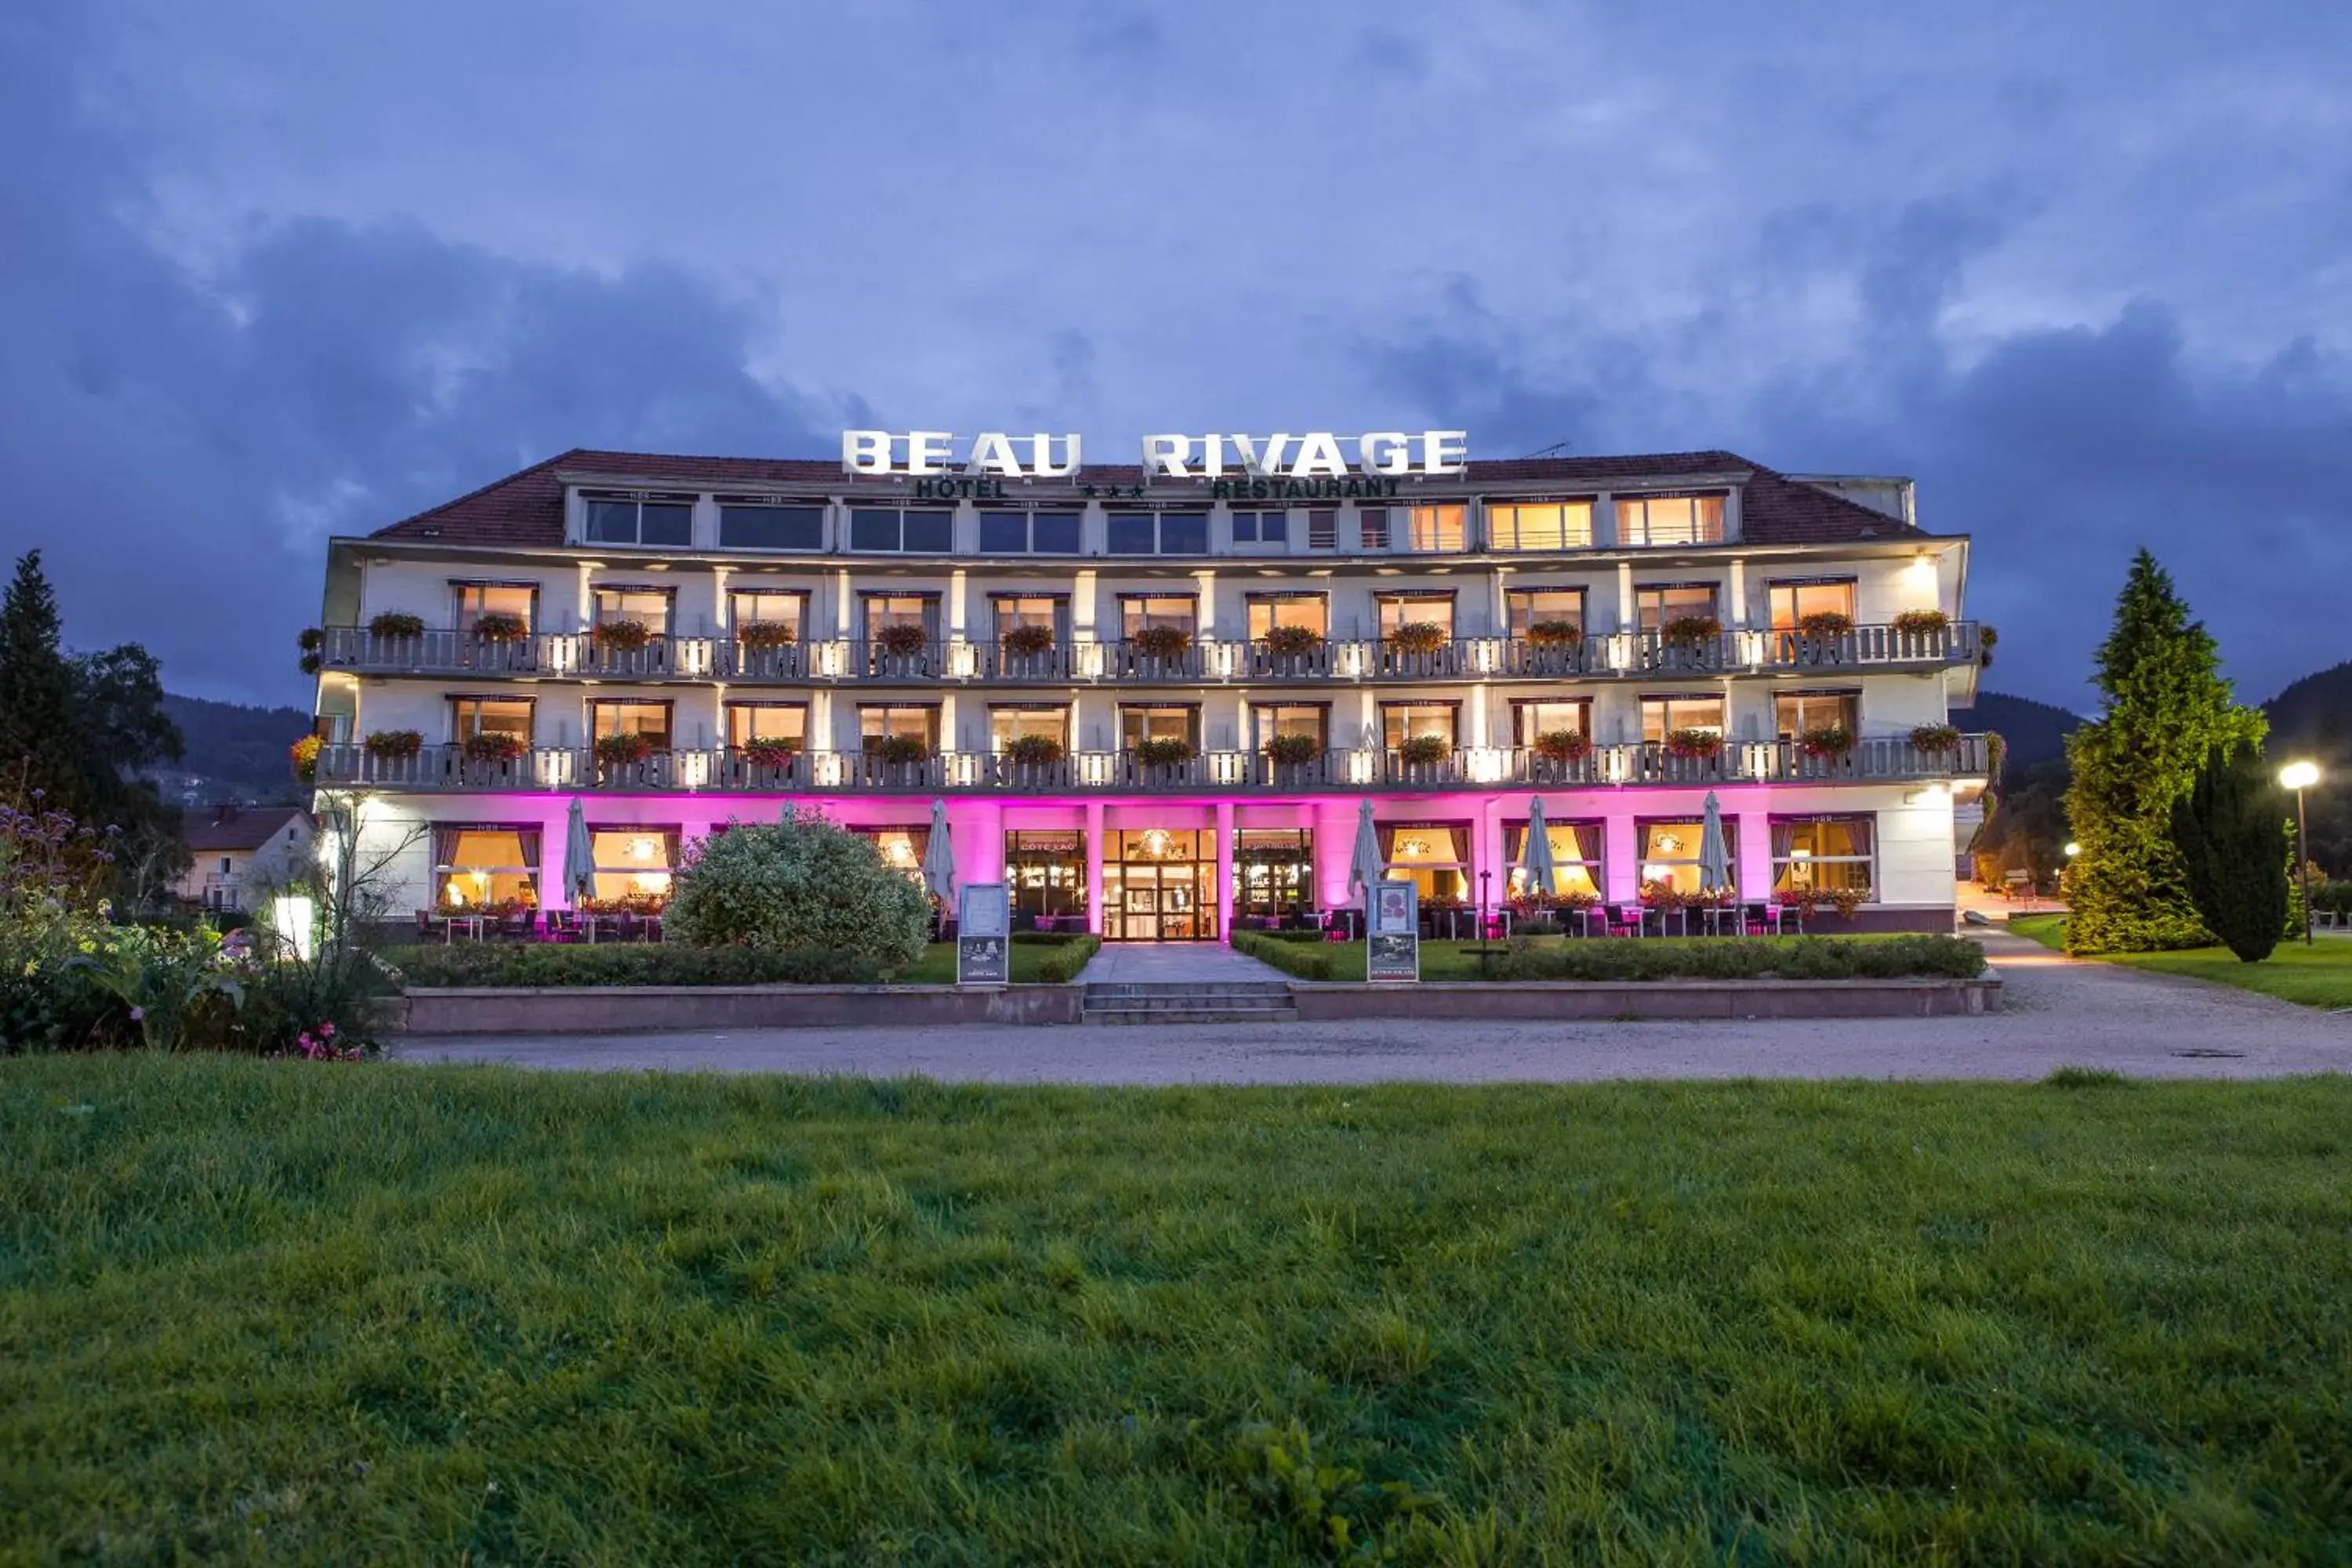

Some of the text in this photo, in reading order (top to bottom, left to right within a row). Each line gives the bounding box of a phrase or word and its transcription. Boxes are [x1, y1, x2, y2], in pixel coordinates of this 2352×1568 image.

[843, 430, 1468, 477] BEAU RIVAGE
[916, 477, 1398, 499] HOTEL RESTAURANT
